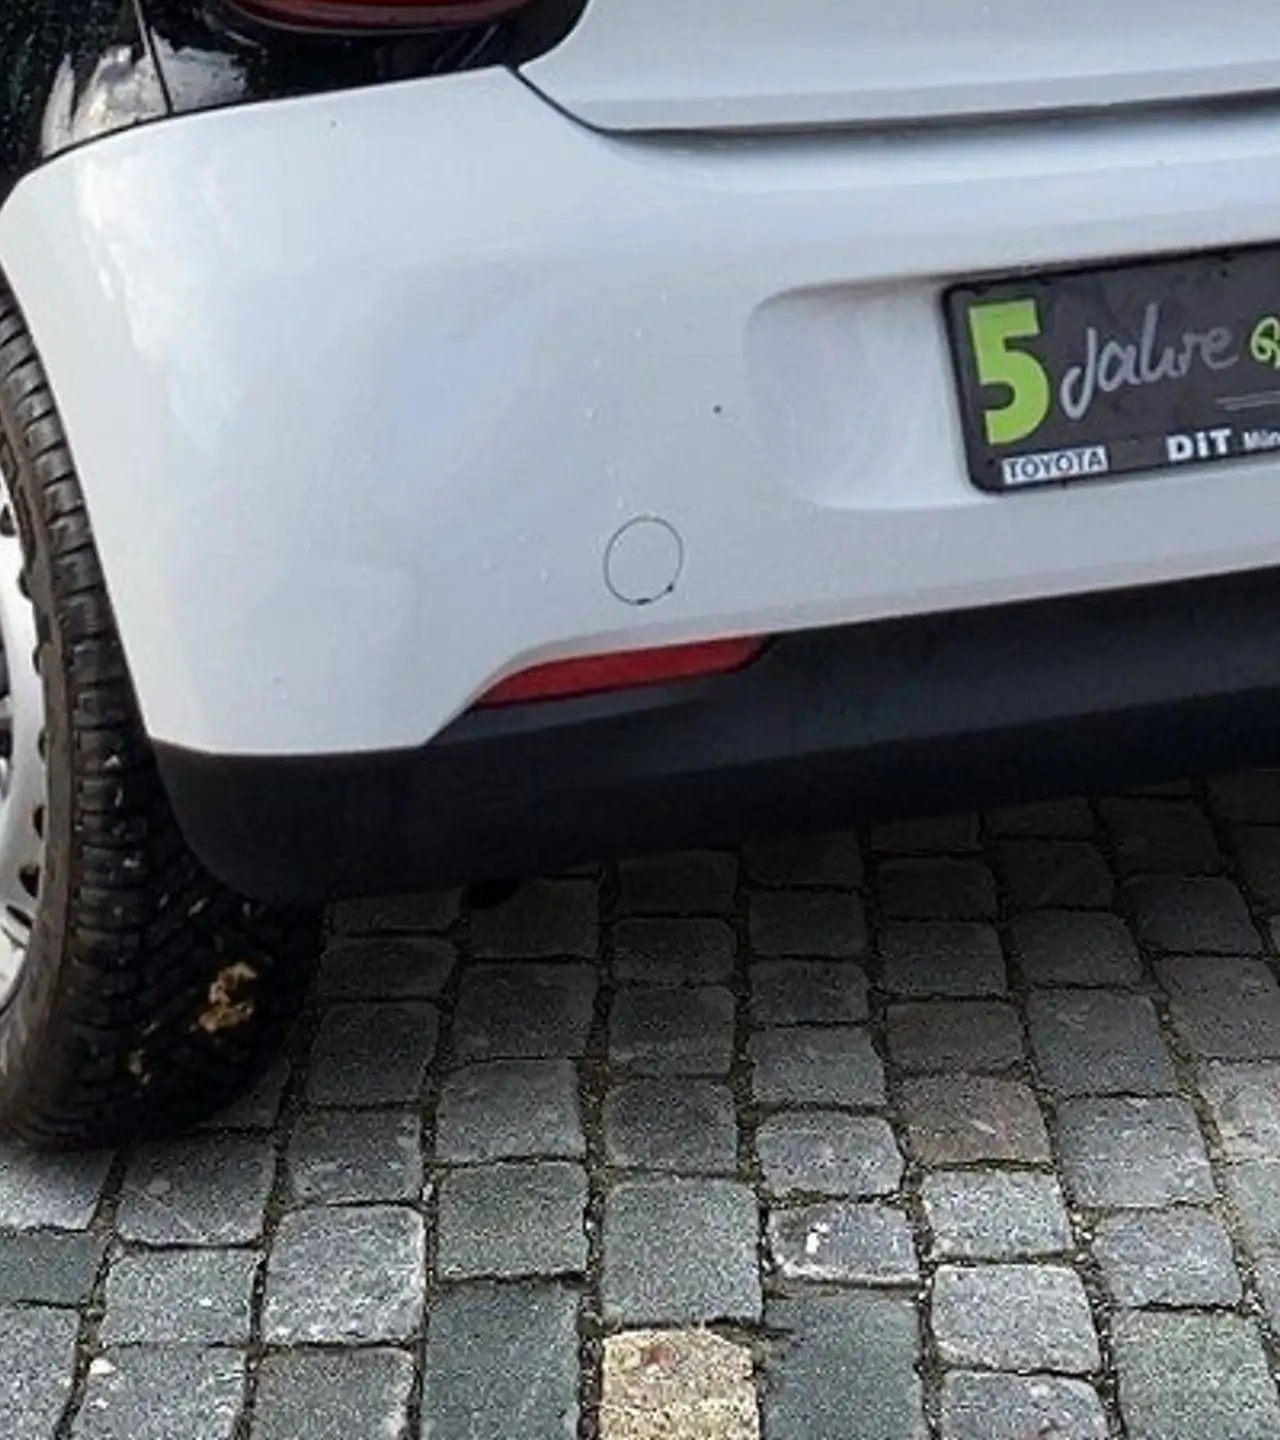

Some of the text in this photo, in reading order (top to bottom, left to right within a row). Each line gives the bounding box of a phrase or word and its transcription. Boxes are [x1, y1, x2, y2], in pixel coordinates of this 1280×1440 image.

[969, 299, 1051, 446] 5
[1059, 301, 1240, 420] Jahre
[1003, 446, 1108, 483] TOYOTA
